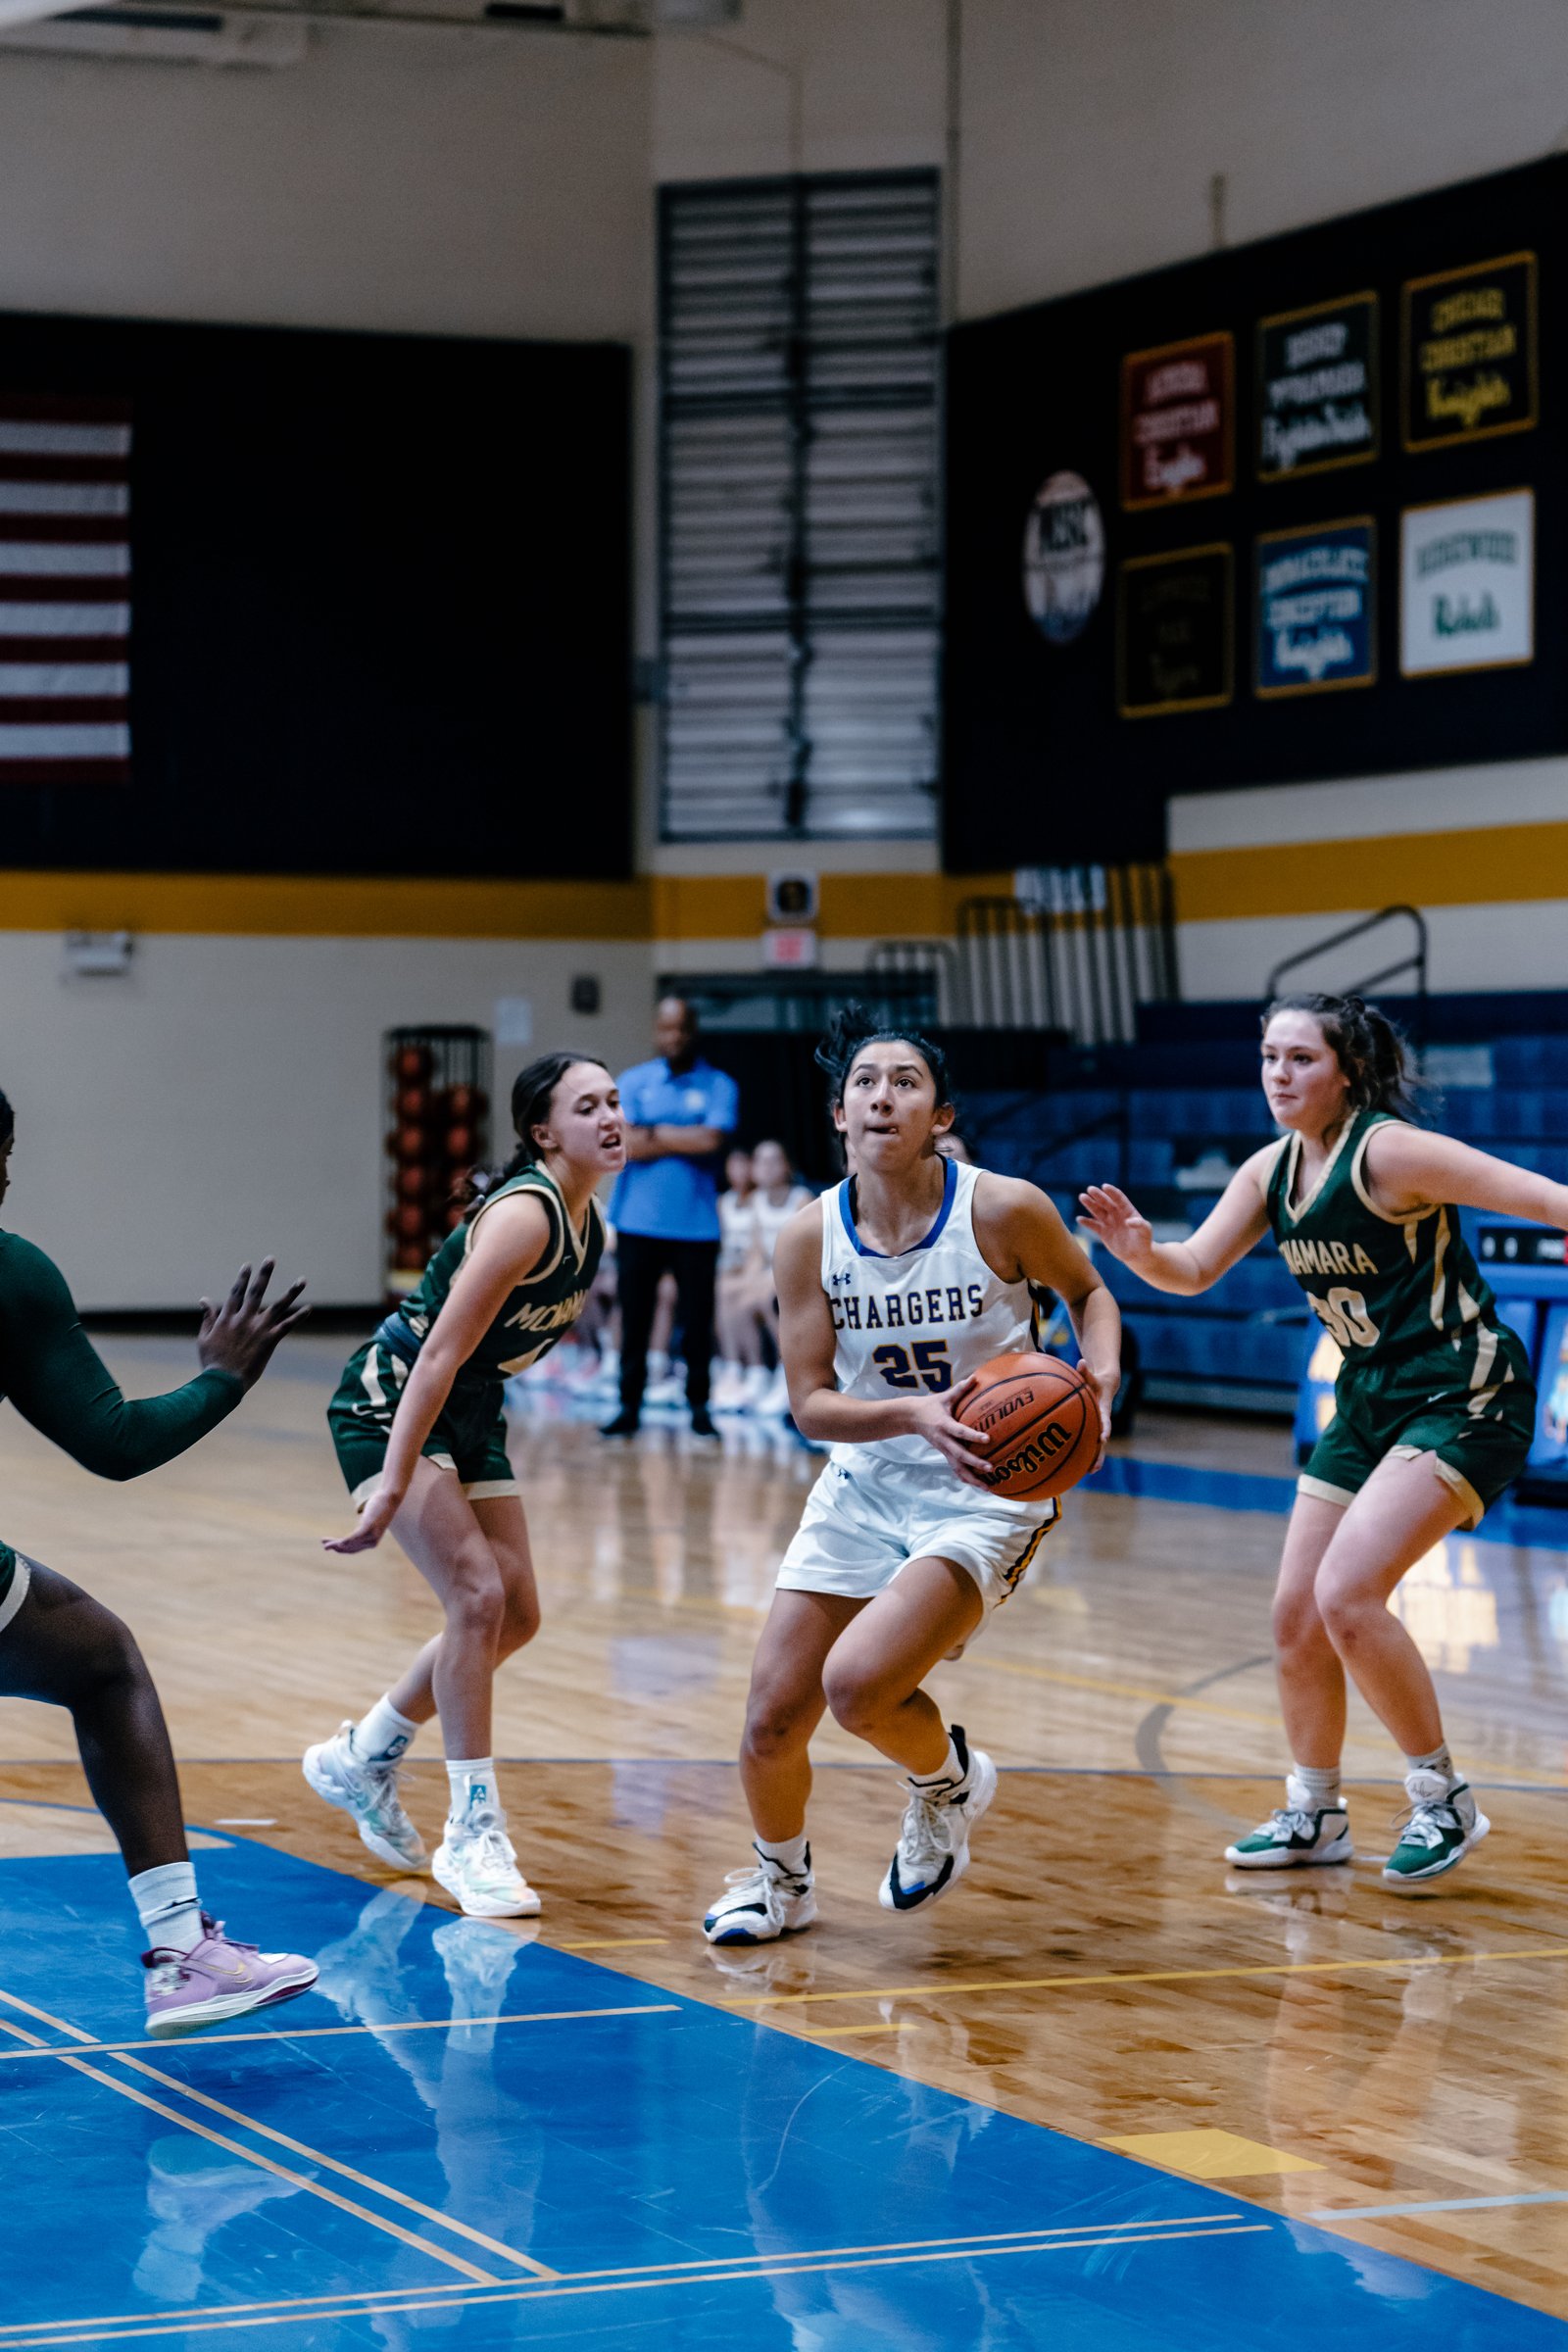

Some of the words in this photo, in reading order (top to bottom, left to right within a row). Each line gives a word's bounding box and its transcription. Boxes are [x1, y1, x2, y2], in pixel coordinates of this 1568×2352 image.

[831, 1284, 983, 1330] CHARGERS
[872, 1339, 953, 1393] 25
[980, 1421, 1072, 1489] Wilson
